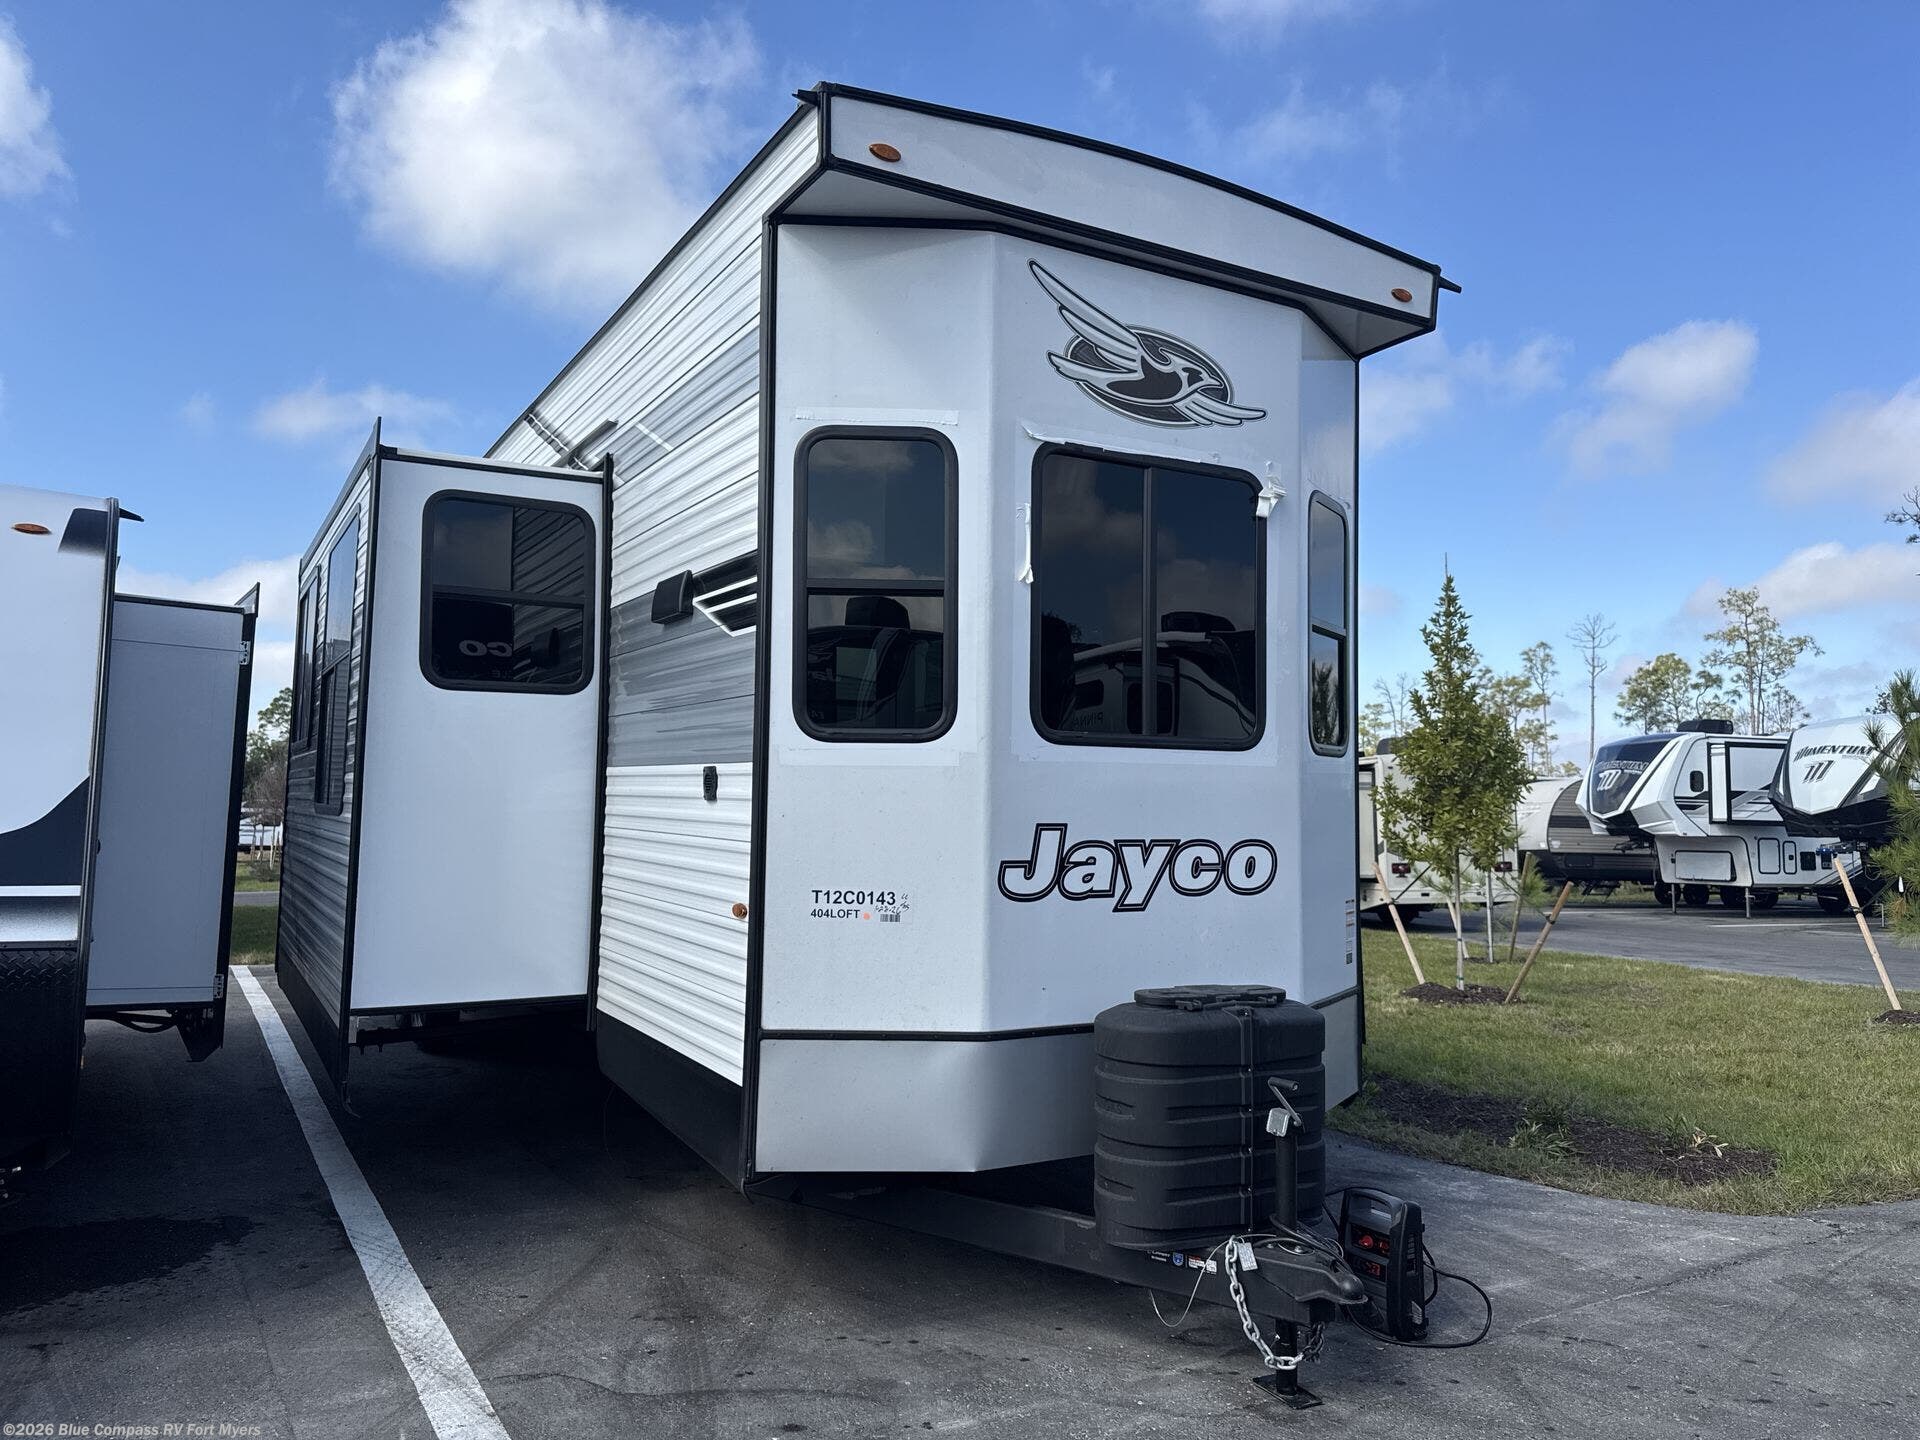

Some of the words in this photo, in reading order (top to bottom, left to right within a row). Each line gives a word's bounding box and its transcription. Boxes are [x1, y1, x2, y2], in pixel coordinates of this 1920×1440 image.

[998, 823, 1277, 912] Jayco
[811, 889, 896, 906] T12C0143
[810, 908, 860, 919] 404LOFT
